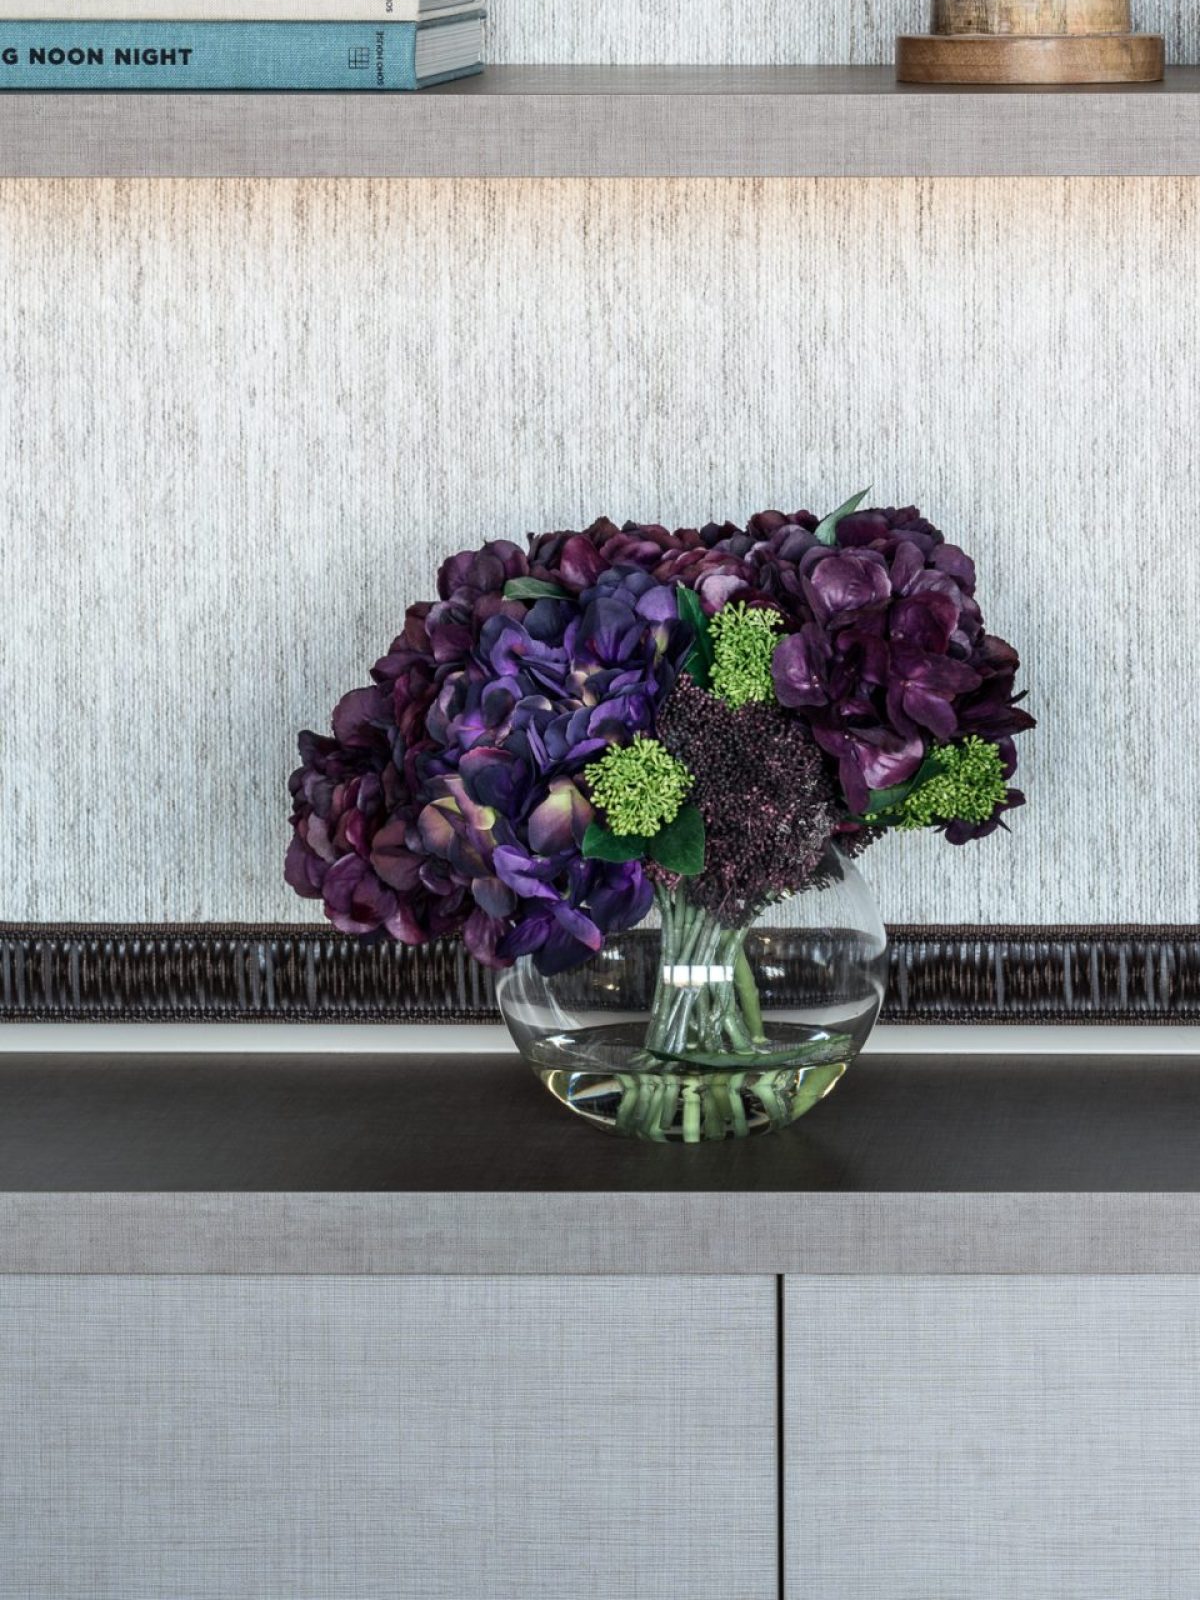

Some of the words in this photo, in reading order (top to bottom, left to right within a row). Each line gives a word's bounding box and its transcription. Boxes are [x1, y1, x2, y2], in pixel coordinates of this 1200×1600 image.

[29, 47, 104, 66] NOON
[115, 47, 193, 66] NIGHT
[376, 62, 384, 86] SOHO
